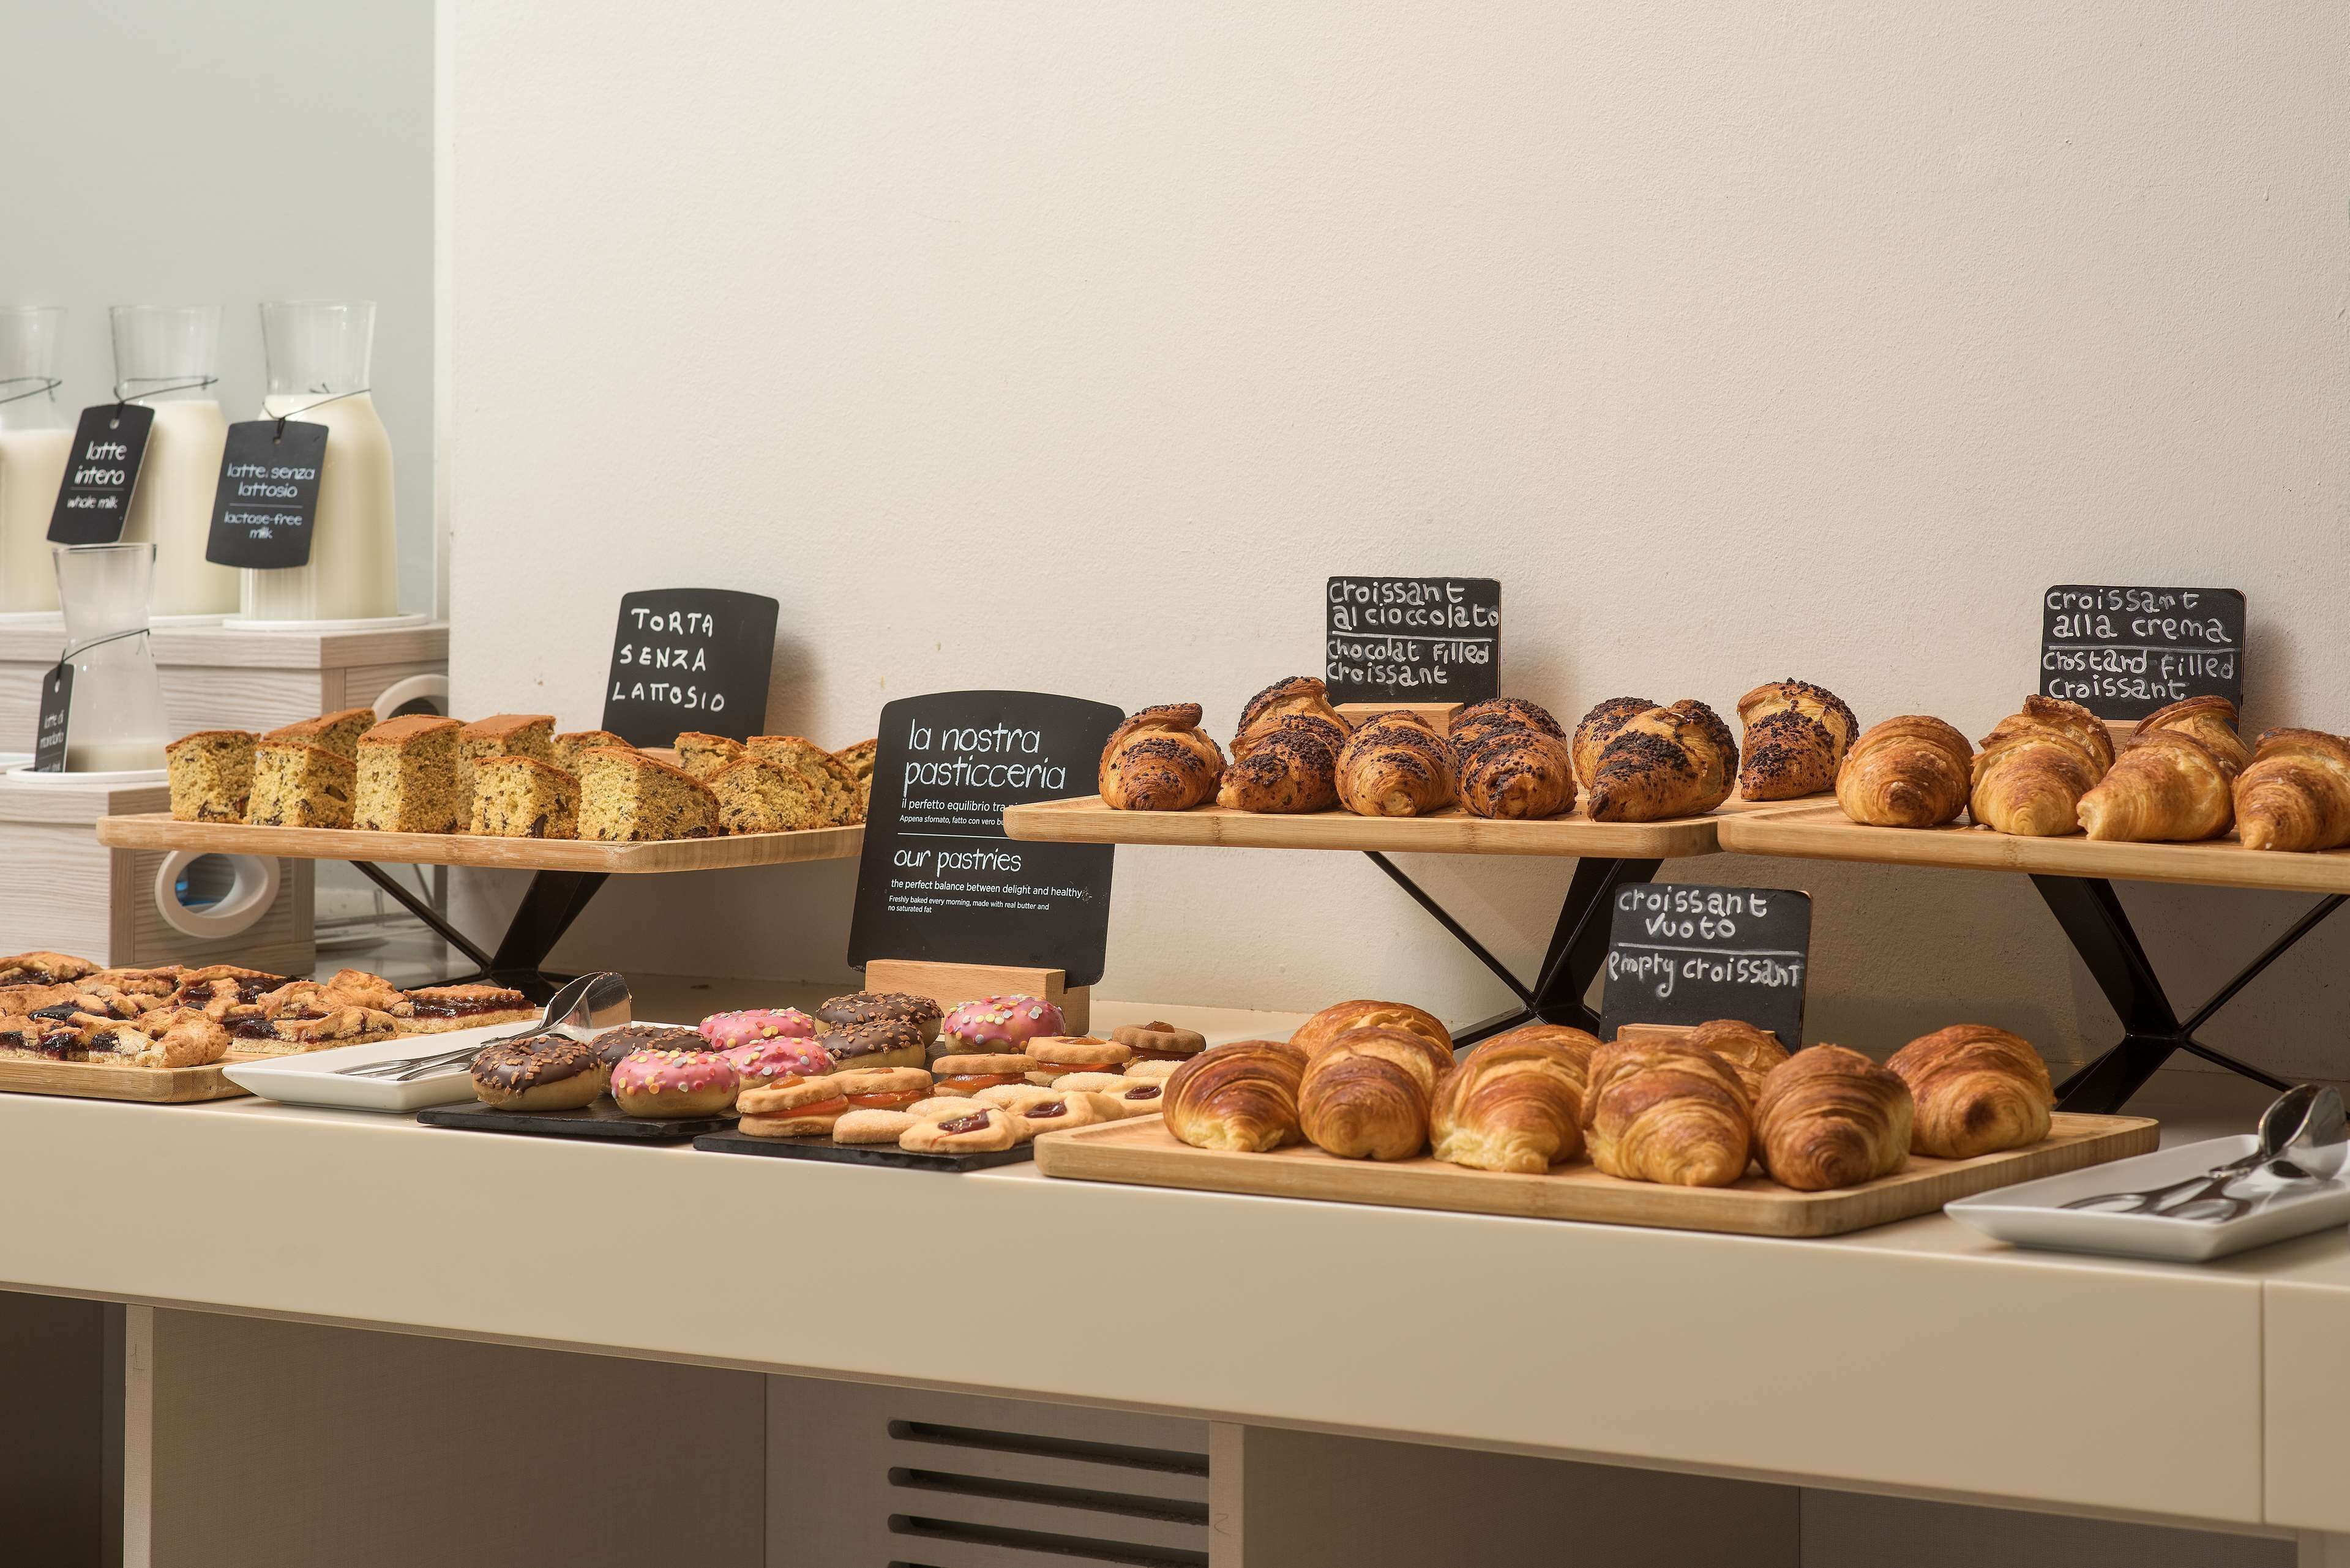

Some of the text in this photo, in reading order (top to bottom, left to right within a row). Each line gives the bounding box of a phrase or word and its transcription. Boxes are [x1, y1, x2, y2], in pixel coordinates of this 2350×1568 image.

[86, 440, 127, 460] latte
[74, 465, 125, 485] intero
[271, 466, 316, 480] senza
[238, 480, 298, 498] lattosio
[67, 495, 119, 509] whole milk
[224, 510, 303, 526] lactose-free
[249, 526, 273, 539] milk
[1329, 580, 1465, 606] croissant
[2046, 588, 2200, 613] croissant
[631, 608, 714, 638] TORTA
[1331, 603, 1499, 631] al cioccolato
[2052, 614, 2232, 643] alla crema
[619, 643, 706, 672] SENZA
[612, 681, 725, 712] LATTOSIO
[908, 718, 1041, 753] la nostra
[903, 755, 1066, 797] pasticceria
[902, 798, 1005, 812] il perfetto equilibrio tra
[899, 815, 923, 824] Appena
[924, 815, 951, 824] sfornato,
[894, 848, 1022, 877] our pastries
[891, 879, 904, 888] the
[905, 880, 933, 889] perfect
[934, 881, 965, 890] balance
[966, 883, 1000, 893] between
[1002, 884, 1031, 895] delight
[1033, 887, 1049, 895] and
[946, 898, 971, 907] morning,
[1619, 886, 1767, 917] croissant
